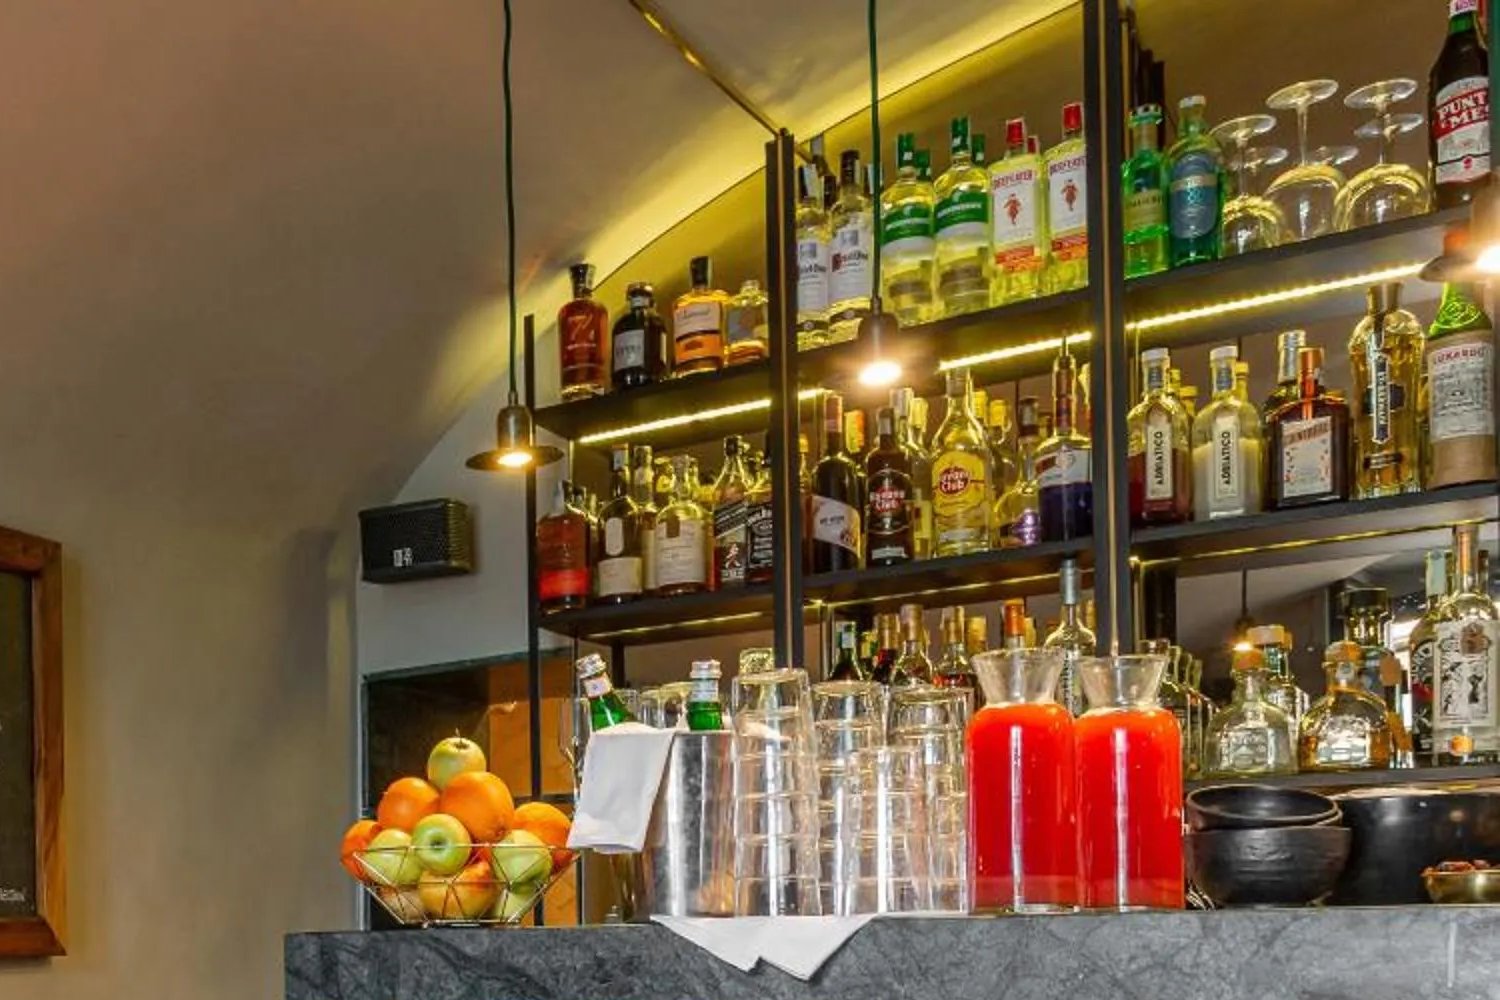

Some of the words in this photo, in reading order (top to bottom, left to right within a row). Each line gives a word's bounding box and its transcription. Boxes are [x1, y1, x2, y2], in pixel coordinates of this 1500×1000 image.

[1437, 92, 1487, 119] PUNT
[1154, 431, 1164, 485] ADRIATICO
[1221, 431, 1231, 485] ADRIATICO
